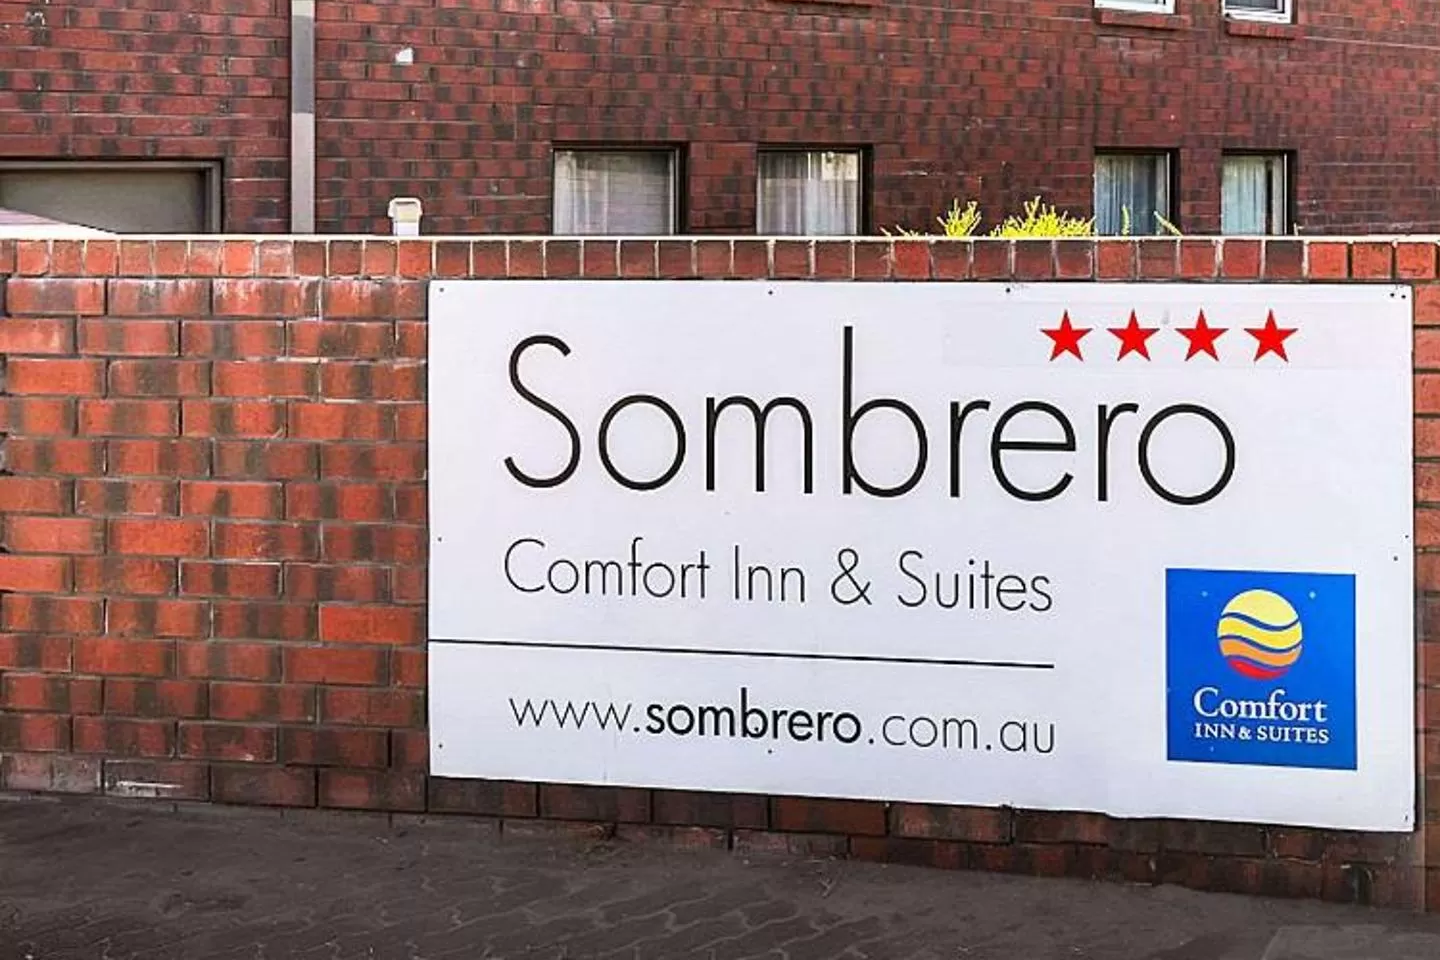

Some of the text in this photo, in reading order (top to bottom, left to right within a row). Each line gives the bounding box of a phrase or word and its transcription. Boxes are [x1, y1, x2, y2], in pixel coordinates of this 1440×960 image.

[503, 325, 1237, 505] Sombrero
[504, 536, 1055, 613] Comfort Inn & Suites
[507, 686, 1056, 755] www.sombrero.com.au
[1193, 686, 1328, 722] Comfort
[1194, 722, 1235, 739] INN
[1256, 725, 1330, 744] SUITES
